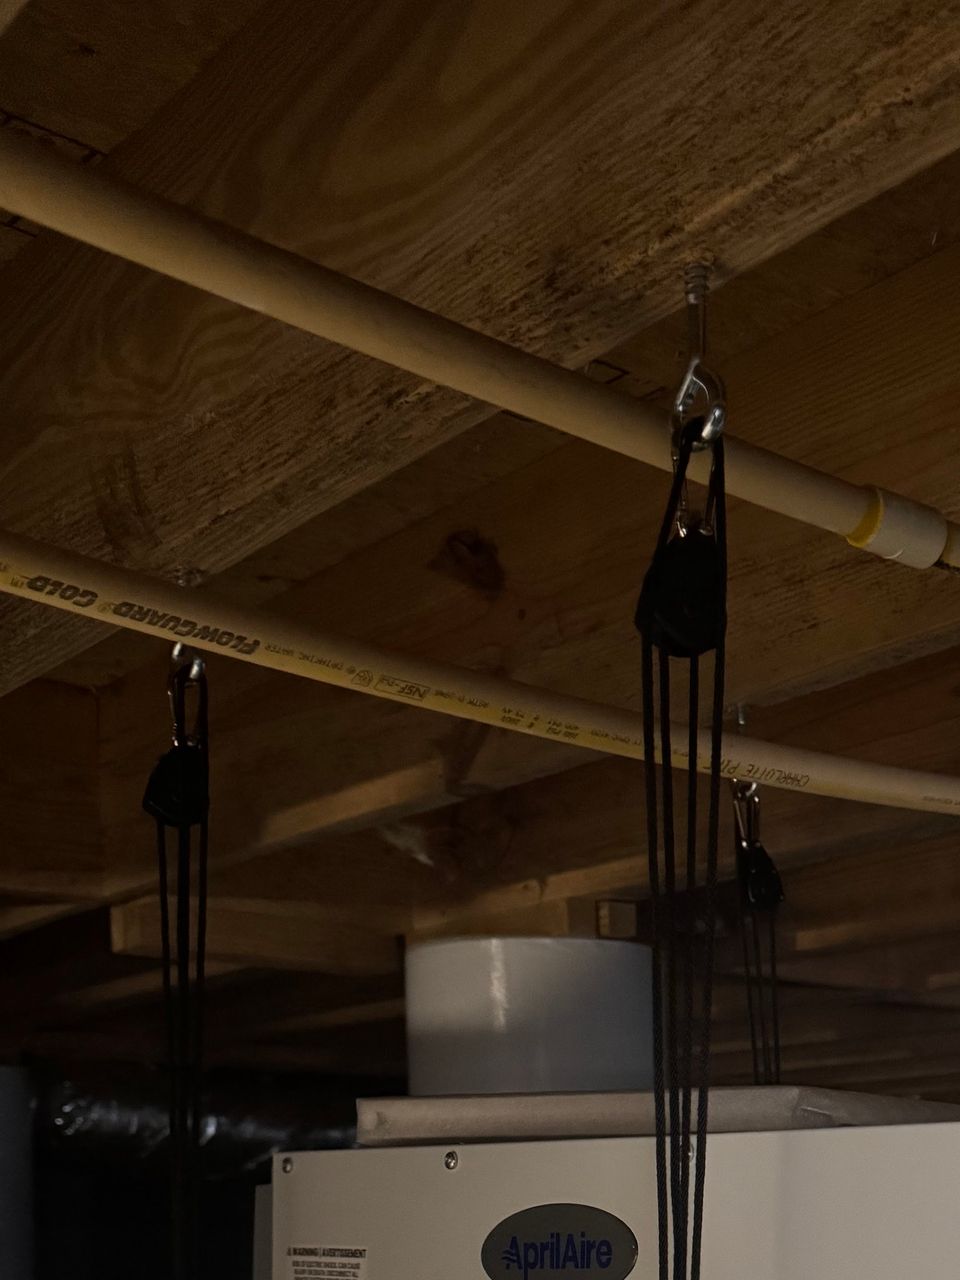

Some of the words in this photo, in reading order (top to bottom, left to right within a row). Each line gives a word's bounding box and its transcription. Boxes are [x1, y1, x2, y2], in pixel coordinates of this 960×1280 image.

[25, 575, 98, 608] GOLD
[111, 601, 261, 655] FLOWGUARD
[740, 763, 810, 788] CHARLOTTE
